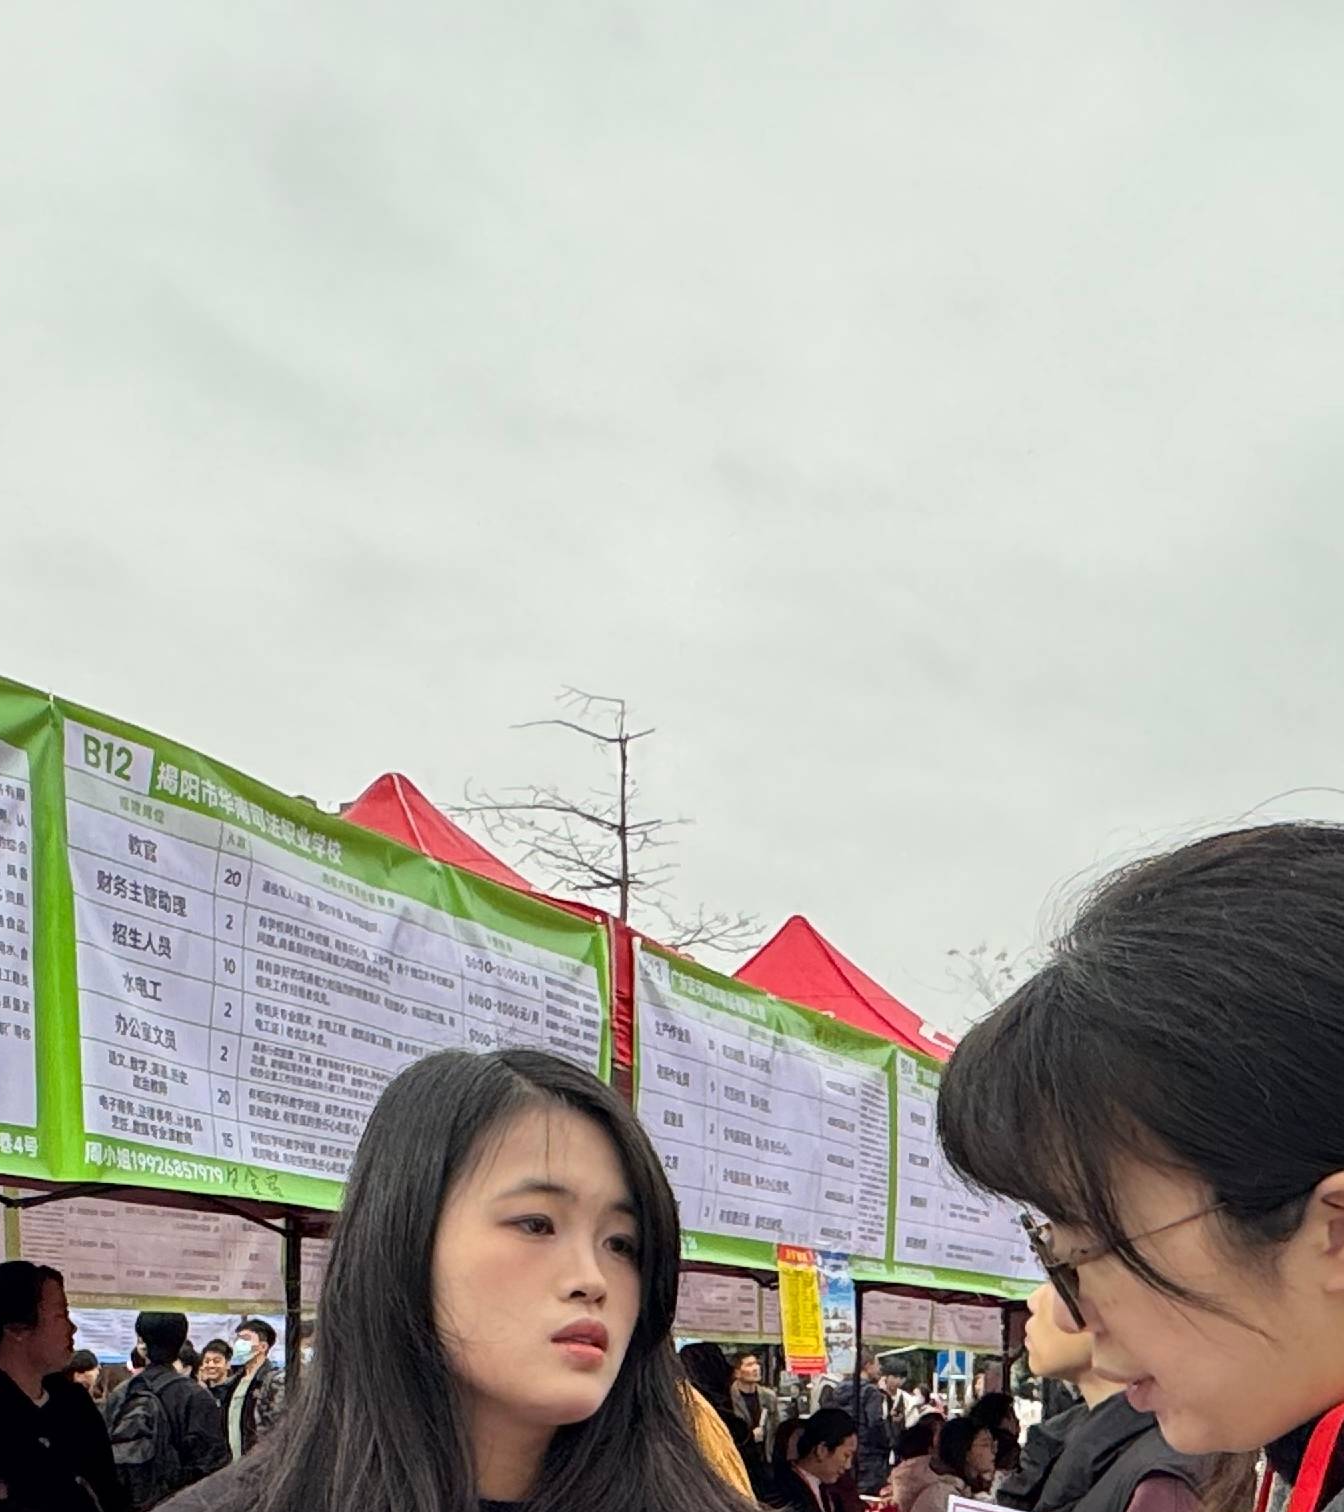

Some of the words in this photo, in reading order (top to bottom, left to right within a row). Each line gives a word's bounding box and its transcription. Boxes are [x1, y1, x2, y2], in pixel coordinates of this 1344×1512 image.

[83, 733, 133, 782] B12
[224, 868, 242, 888] 20
[224, 914, 234, 931] 2
[111, 921, 173, 961] 招生人员
[223, 956, 237, 976] 10
[122, 971, 163, 1002] 水电工
[223, 1001, 232, 1020] 2
[113, 1012, 178, 1053] 办公室文员
[219, 1045, 228, 1062] 2
